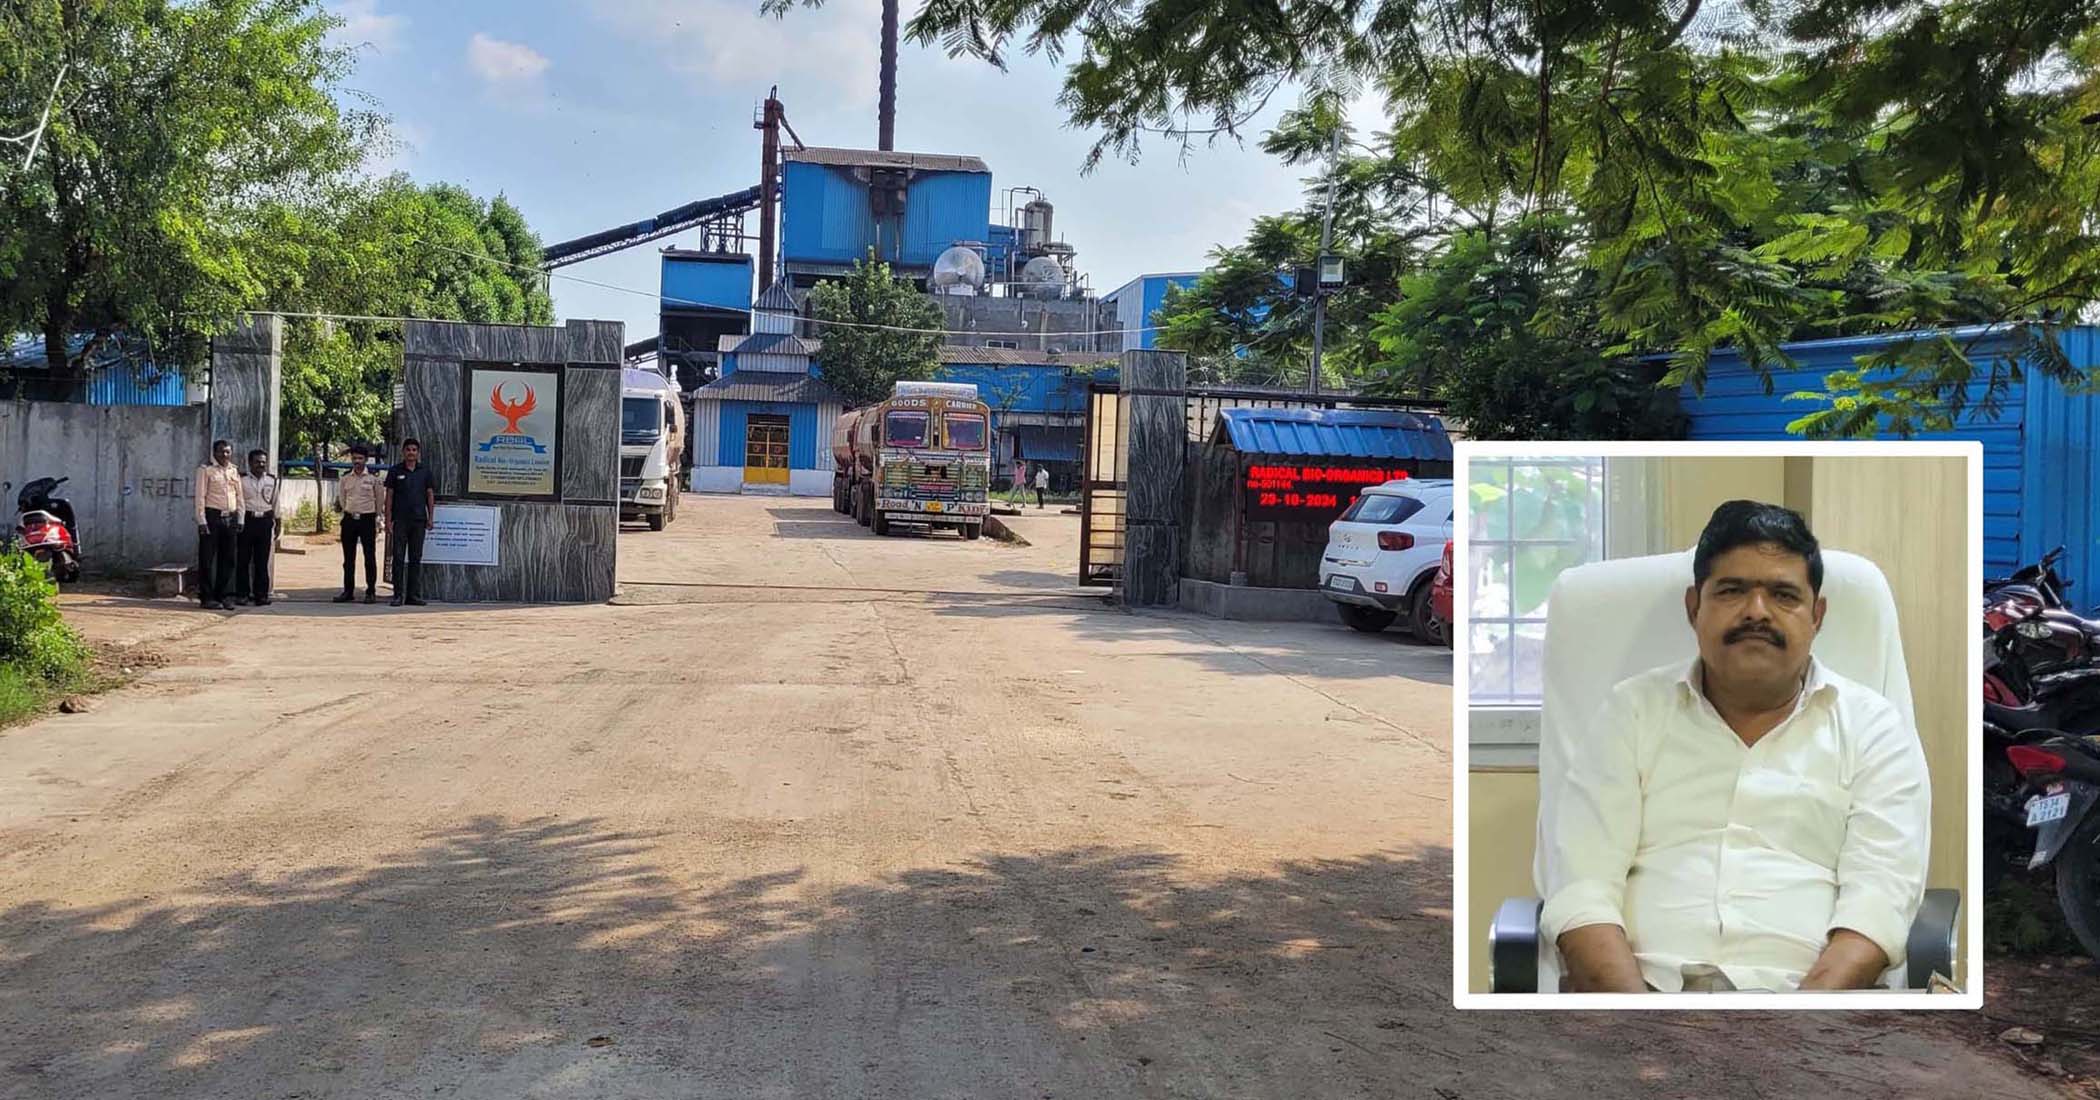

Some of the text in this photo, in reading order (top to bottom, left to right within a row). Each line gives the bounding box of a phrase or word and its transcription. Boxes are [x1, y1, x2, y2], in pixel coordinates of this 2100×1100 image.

[891, 399, 926, 407] GOODS
[1250, 466, 1299, 480] RADICAL
[1302, 468, 1384, 482] BIO-ORGANICS
[881, 499, 909, 509] Road
